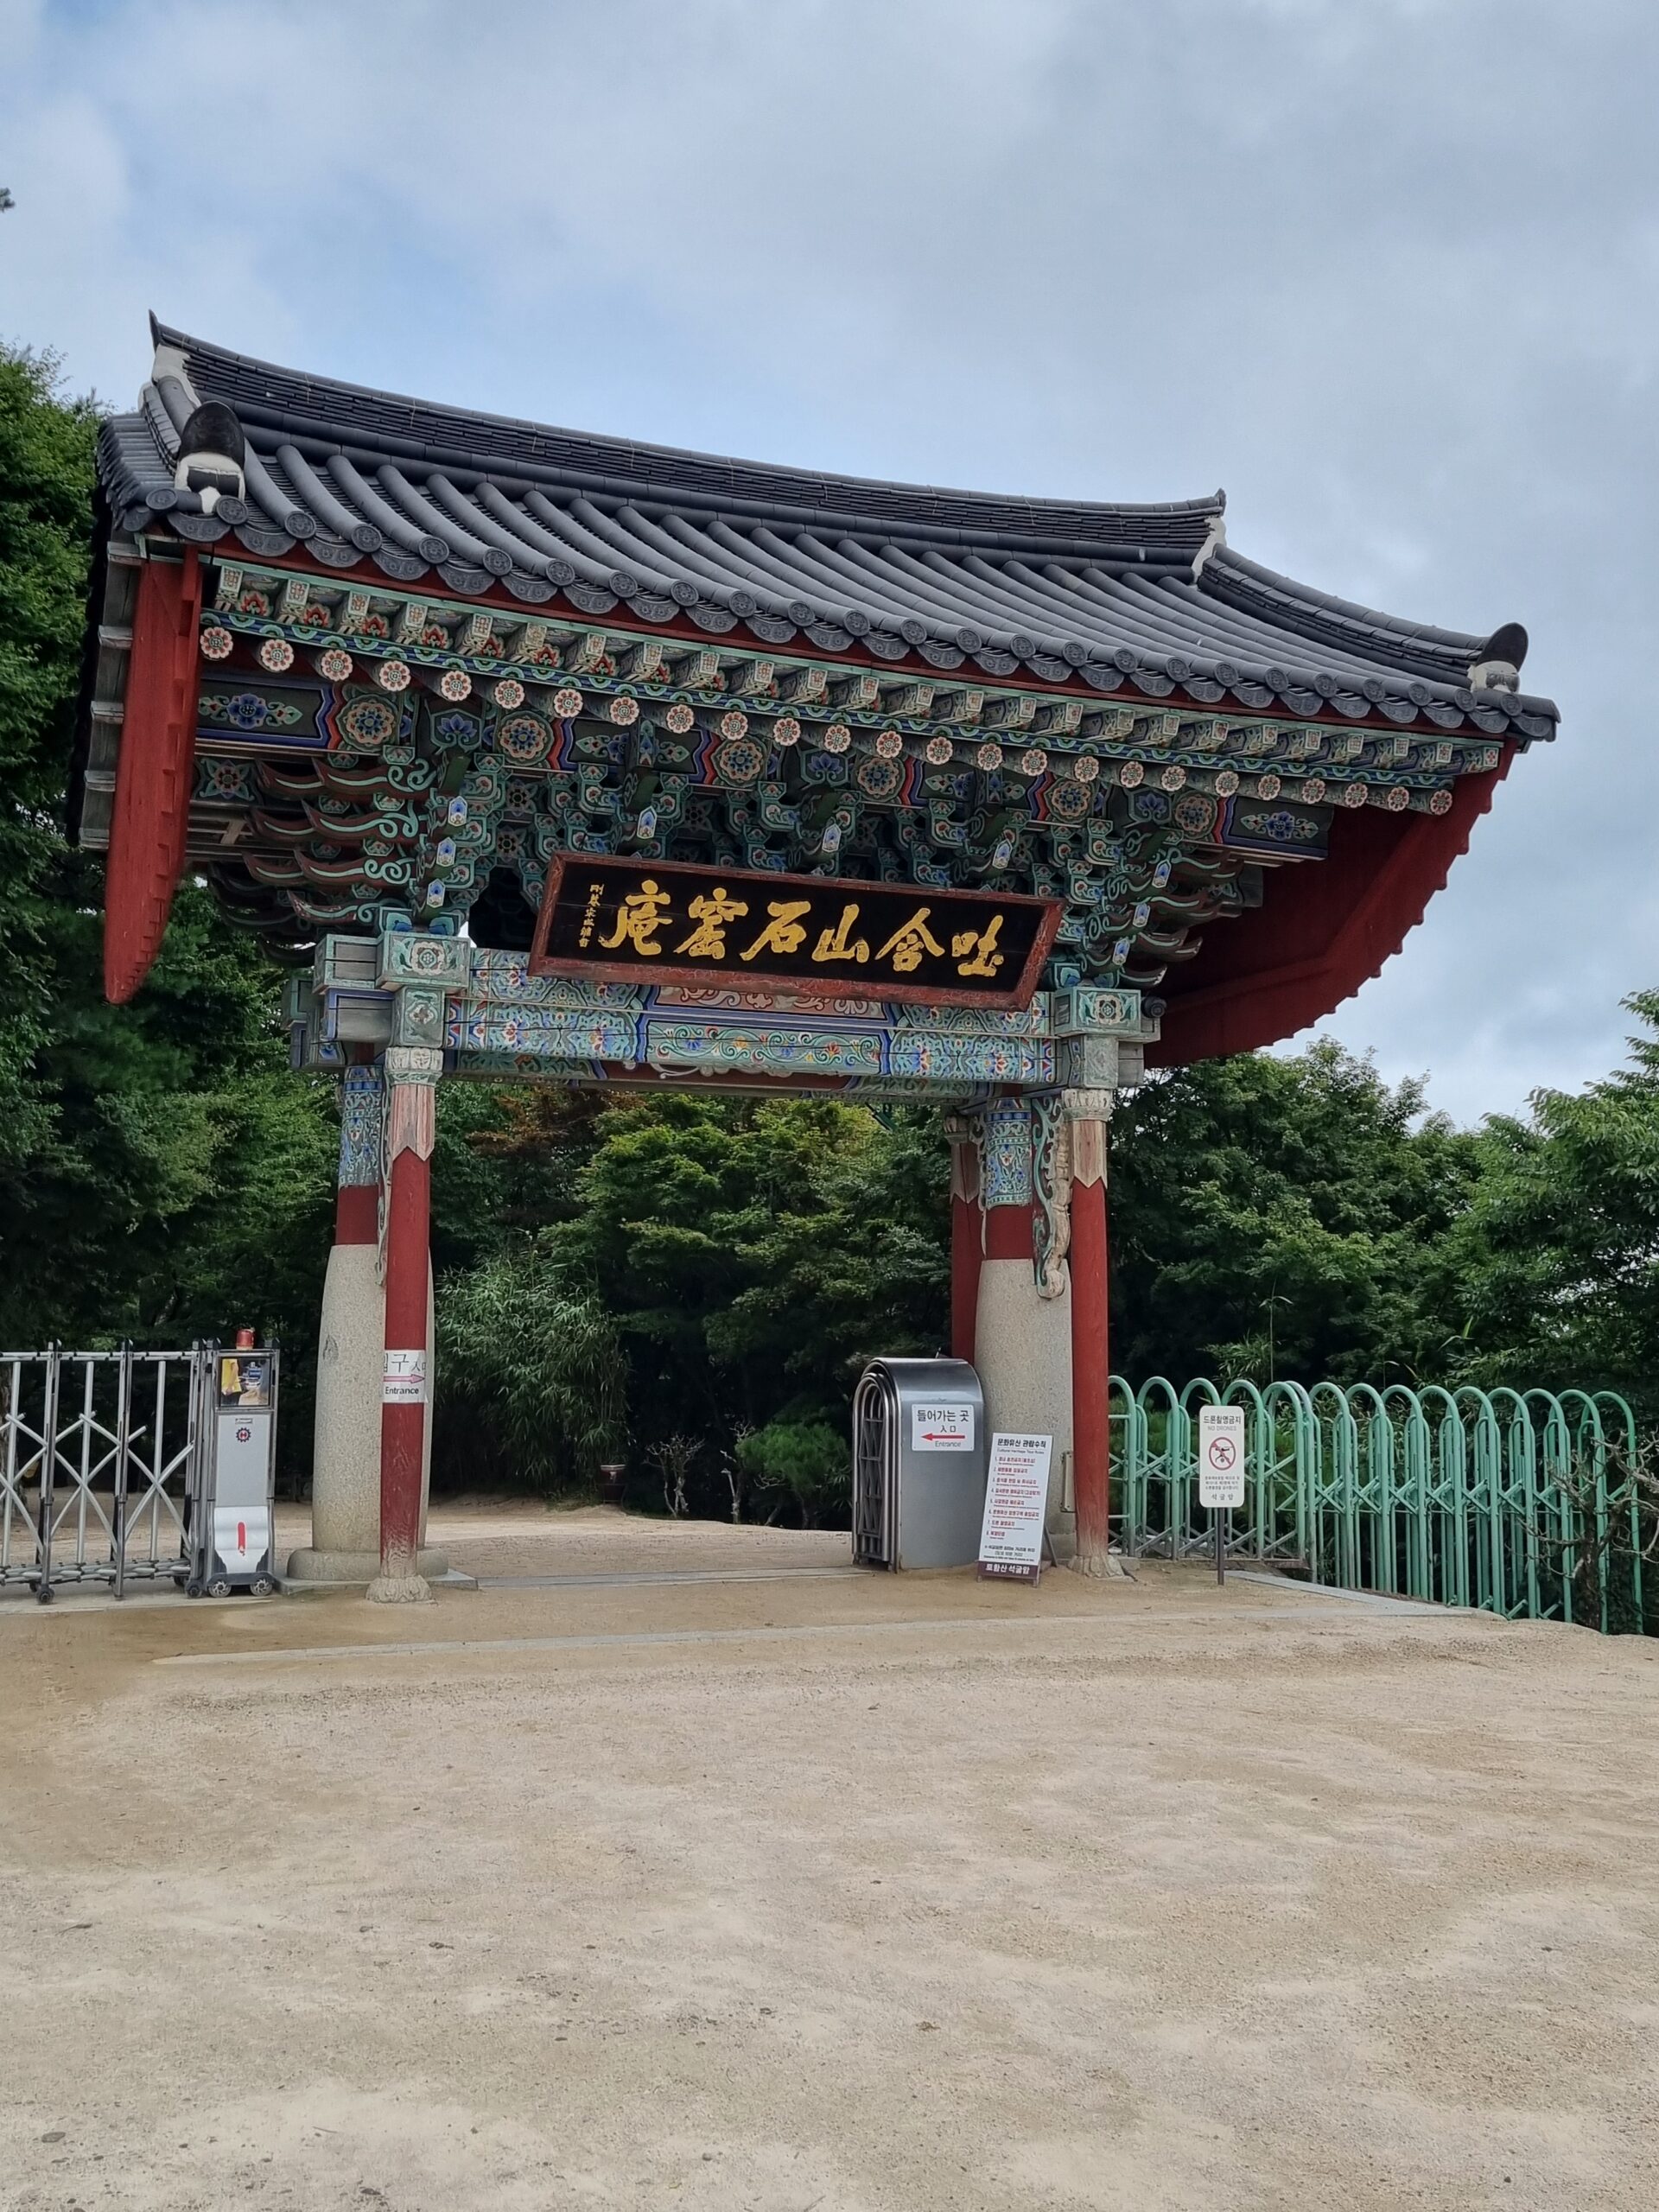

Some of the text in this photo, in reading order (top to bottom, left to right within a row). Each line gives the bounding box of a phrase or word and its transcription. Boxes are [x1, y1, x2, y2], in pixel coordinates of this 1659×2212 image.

[385, 1386, 419, 1395] Entrance
[917, 1409, 969, 1422] 들어가는 곳
[1203, 1415, 1242, 1425] 드론촬영금지
[997, 1438, 1021, 1447] 문화유산
[986, 1563, 1030, 1575] 토함산 석굴암
